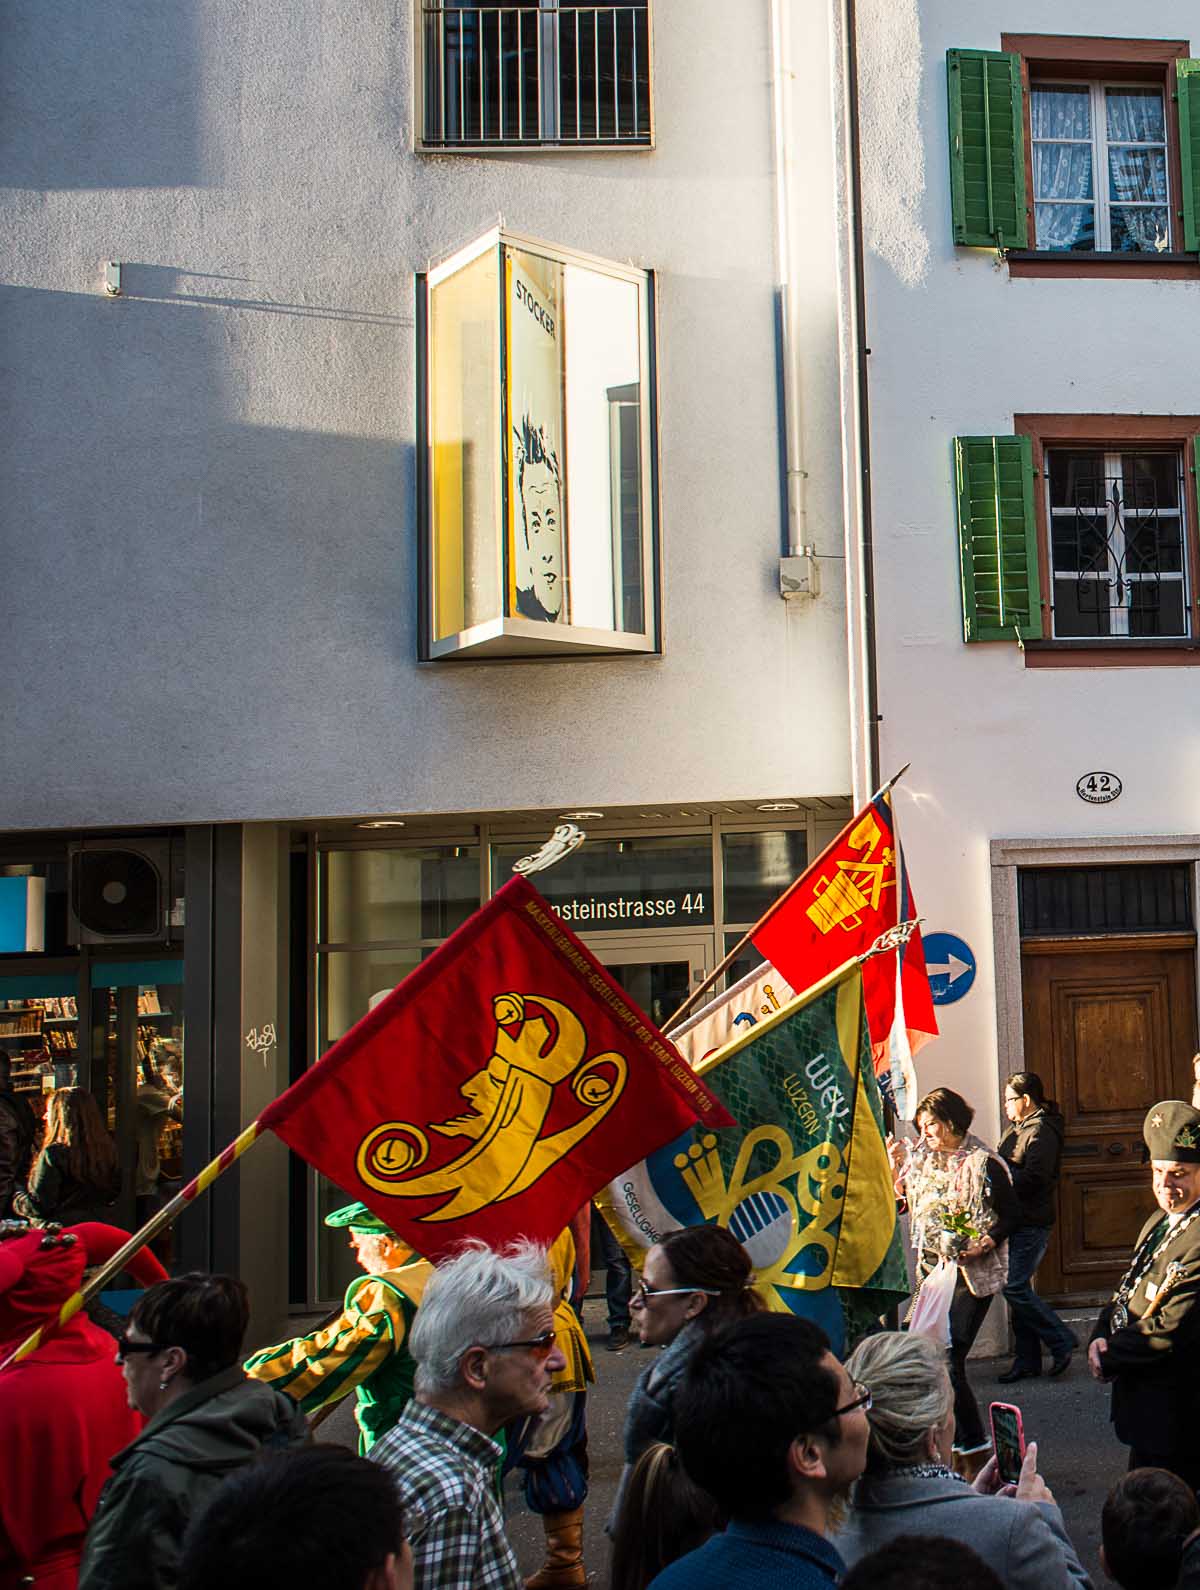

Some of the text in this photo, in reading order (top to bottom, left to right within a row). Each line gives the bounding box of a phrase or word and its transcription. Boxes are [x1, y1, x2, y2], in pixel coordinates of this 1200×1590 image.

[516, 279, 556, 340] STOCKER
[1087, 775, 1111, 792] 42
[682, 893, 705, 914] 44
[635, 1026, 653, 1044] DER
[649, 1041, 675, 1066] STADT
[670, 1064, 699, 1093] LUZERN
[784, 1073, 822, 1136] LUZERN
